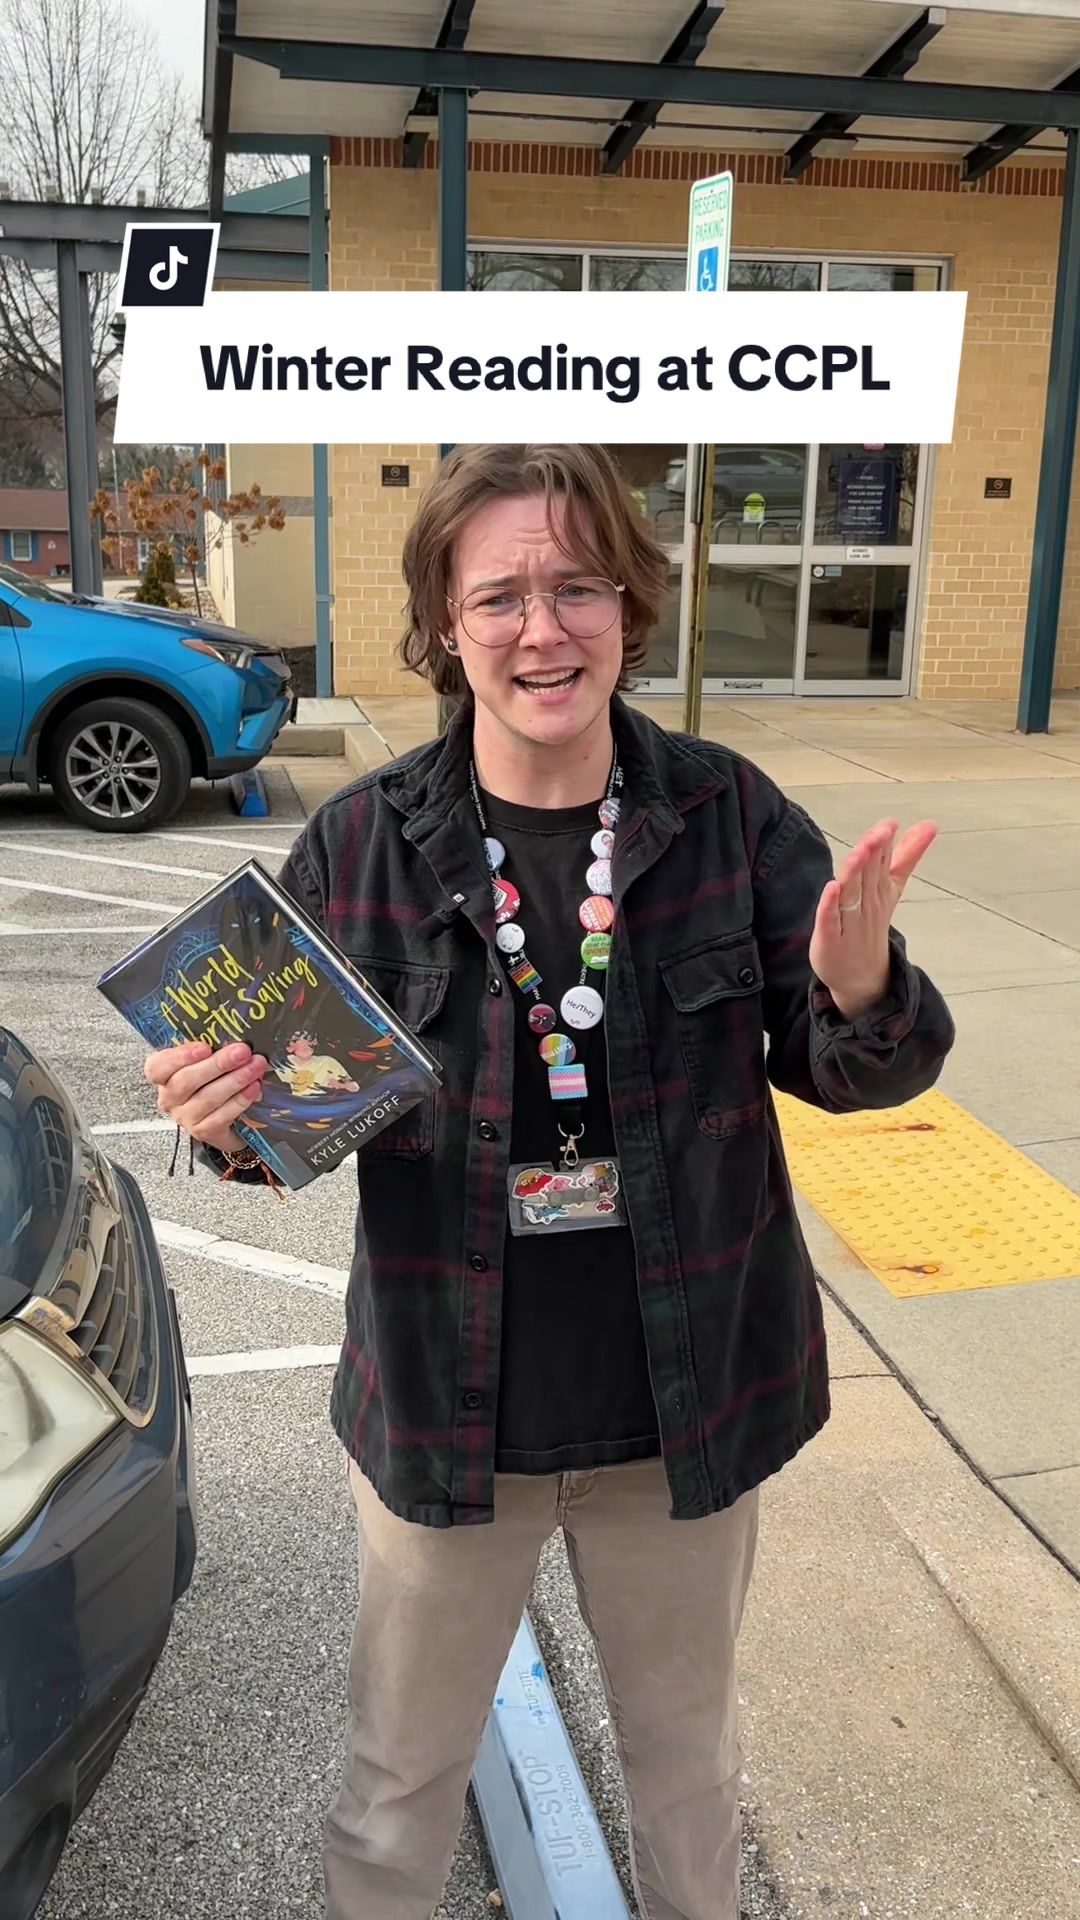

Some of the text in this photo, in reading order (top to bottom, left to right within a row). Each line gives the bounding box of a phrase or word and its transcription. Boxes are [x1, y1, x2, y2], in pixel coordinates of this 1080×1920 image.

[693, 190, 728, 217] RESERVED
[695, 219, 724, 243] PARKING
[160, 944, 255, 1030] A World
[237, 954, 318, 1021] Saving
[566, 1000, 597, 1019] He/They
[310, 1095, 400, 1166] KYLE LUKOFF
[521, 1754, 583, 1878] TUF-STOP
